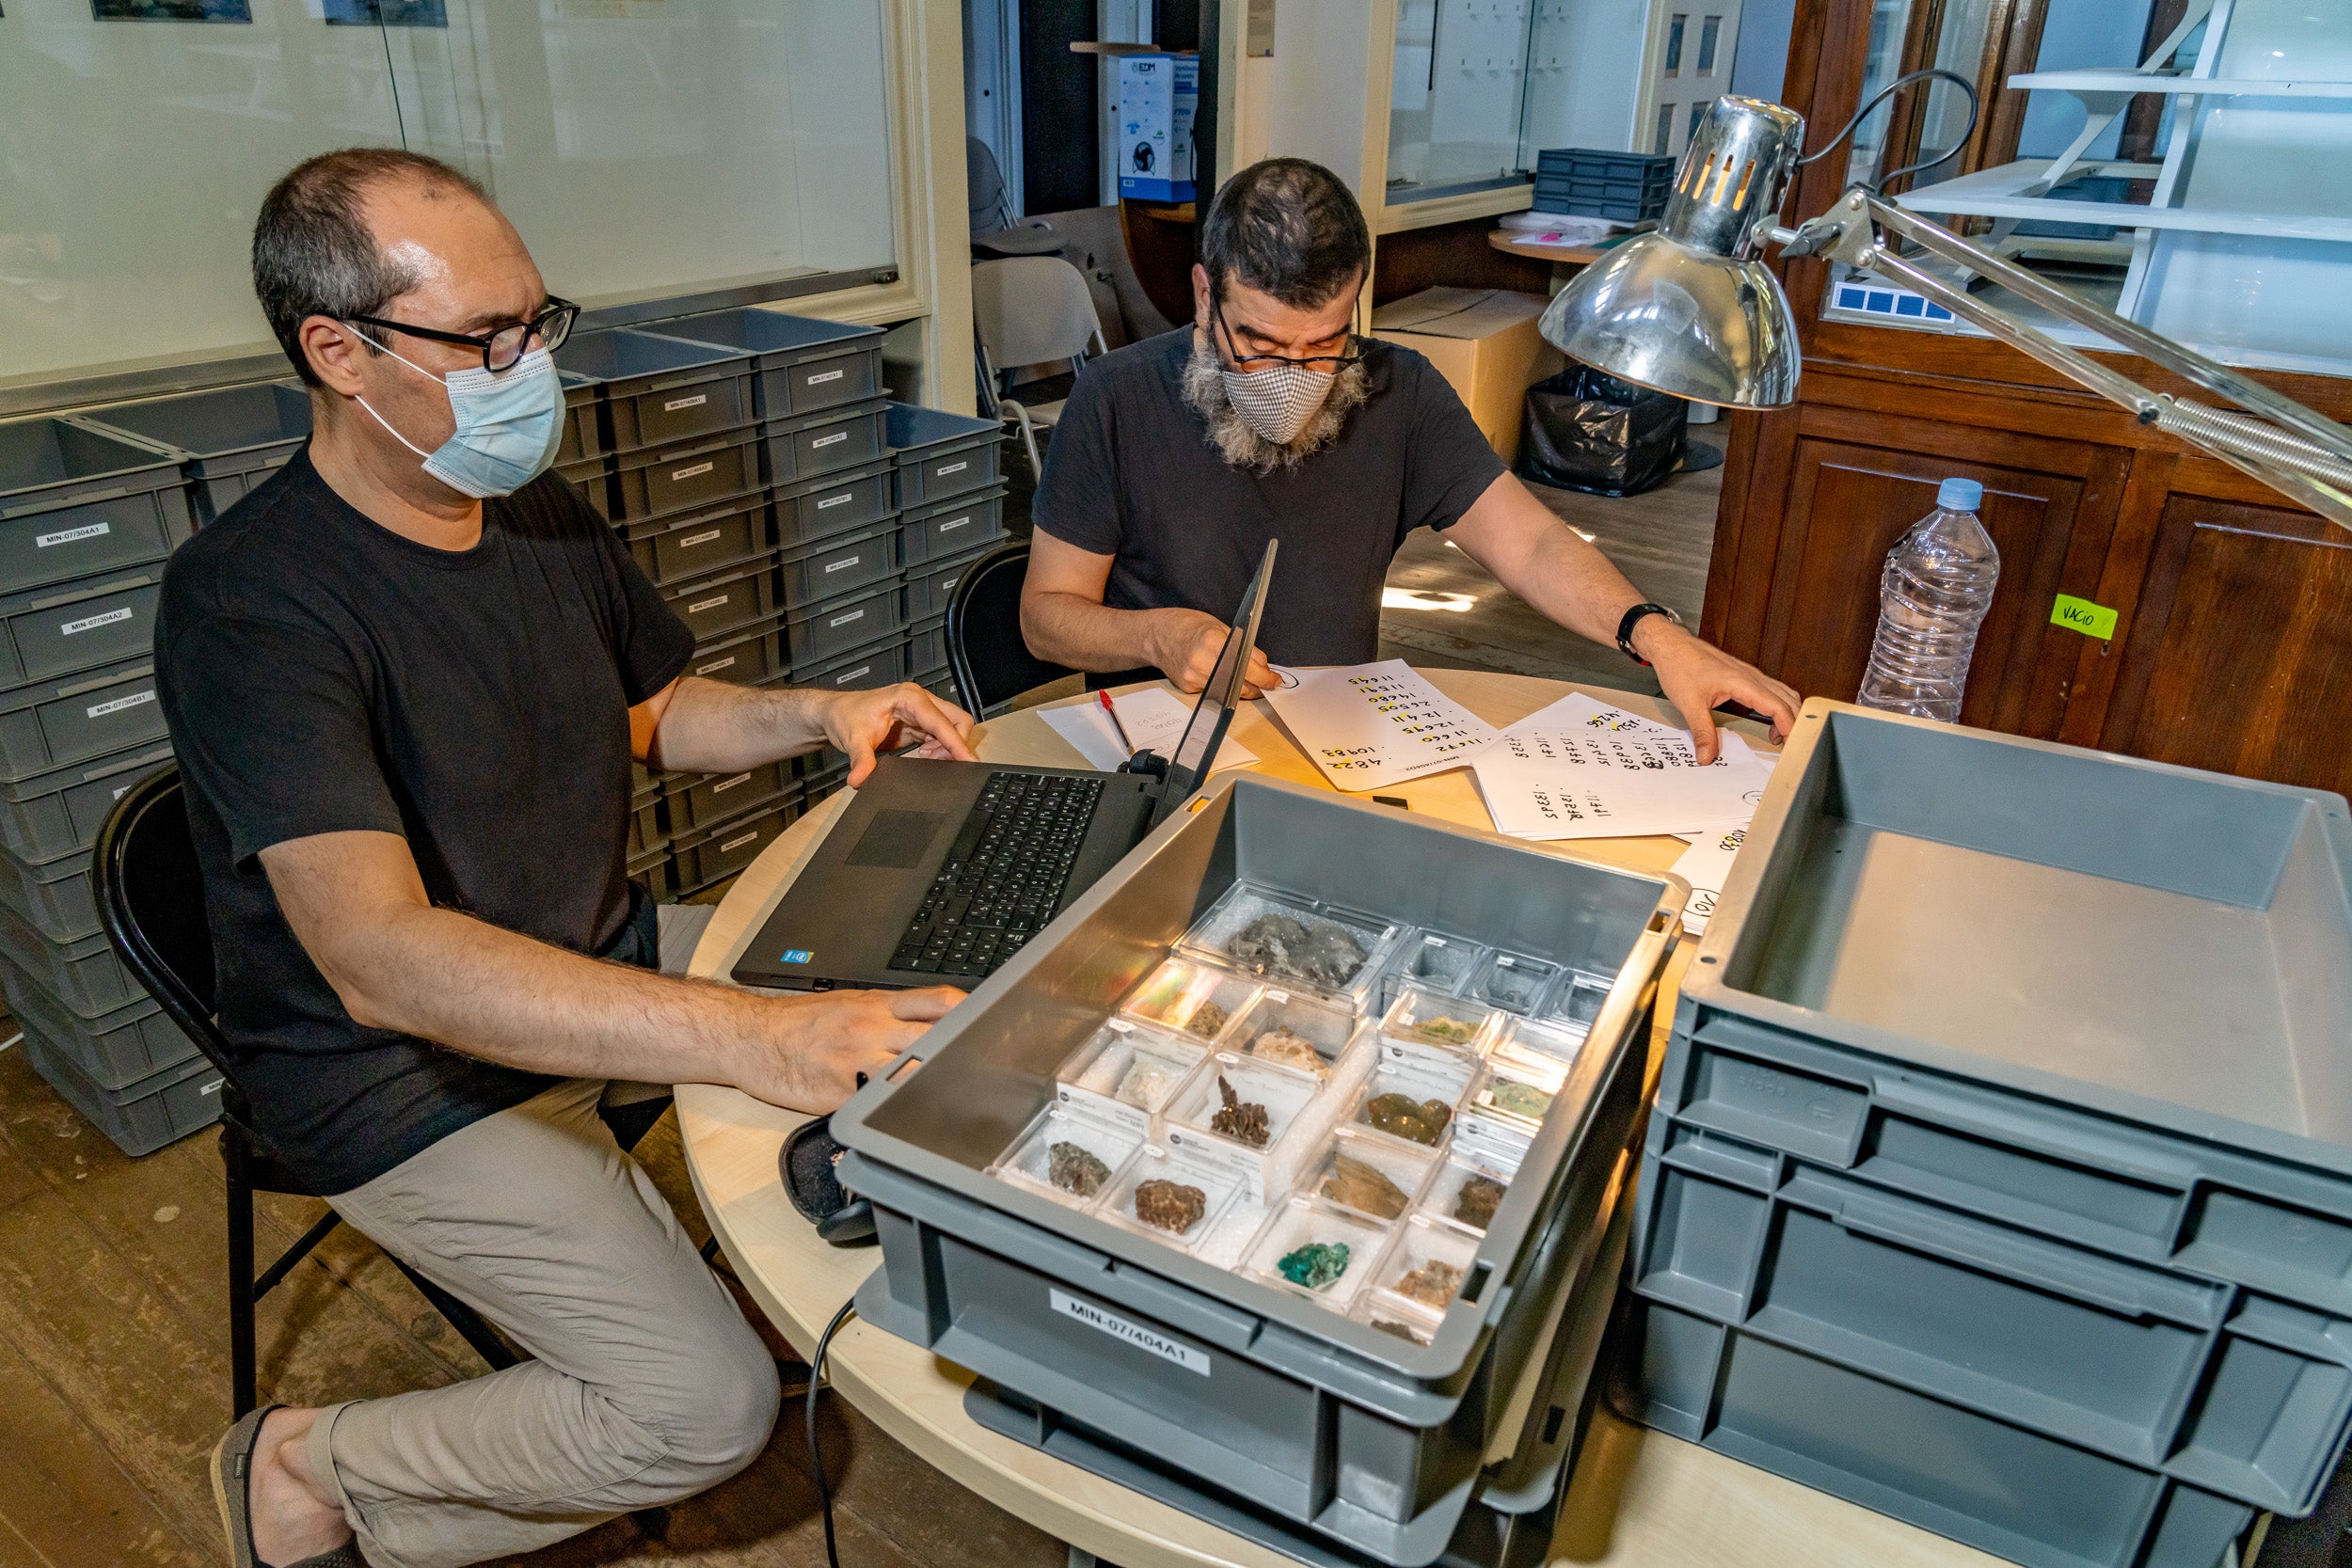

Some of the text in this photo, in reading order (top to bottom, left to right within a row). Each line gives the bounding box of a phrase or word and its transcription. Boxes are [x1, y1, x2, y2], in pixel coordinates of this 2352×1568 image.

[1138, 63, 1156, 71] EDM
[46, 527, 100, 543] MIN-07/304A1
[72, 612, 122, 631] MIN-07/304A2
[96, 694, 146, 714] MIN-07/304B1
[1326, 758, 1382, 769] 4822
[1071, 1302, 1186, 1361] MIN-07/404A1
